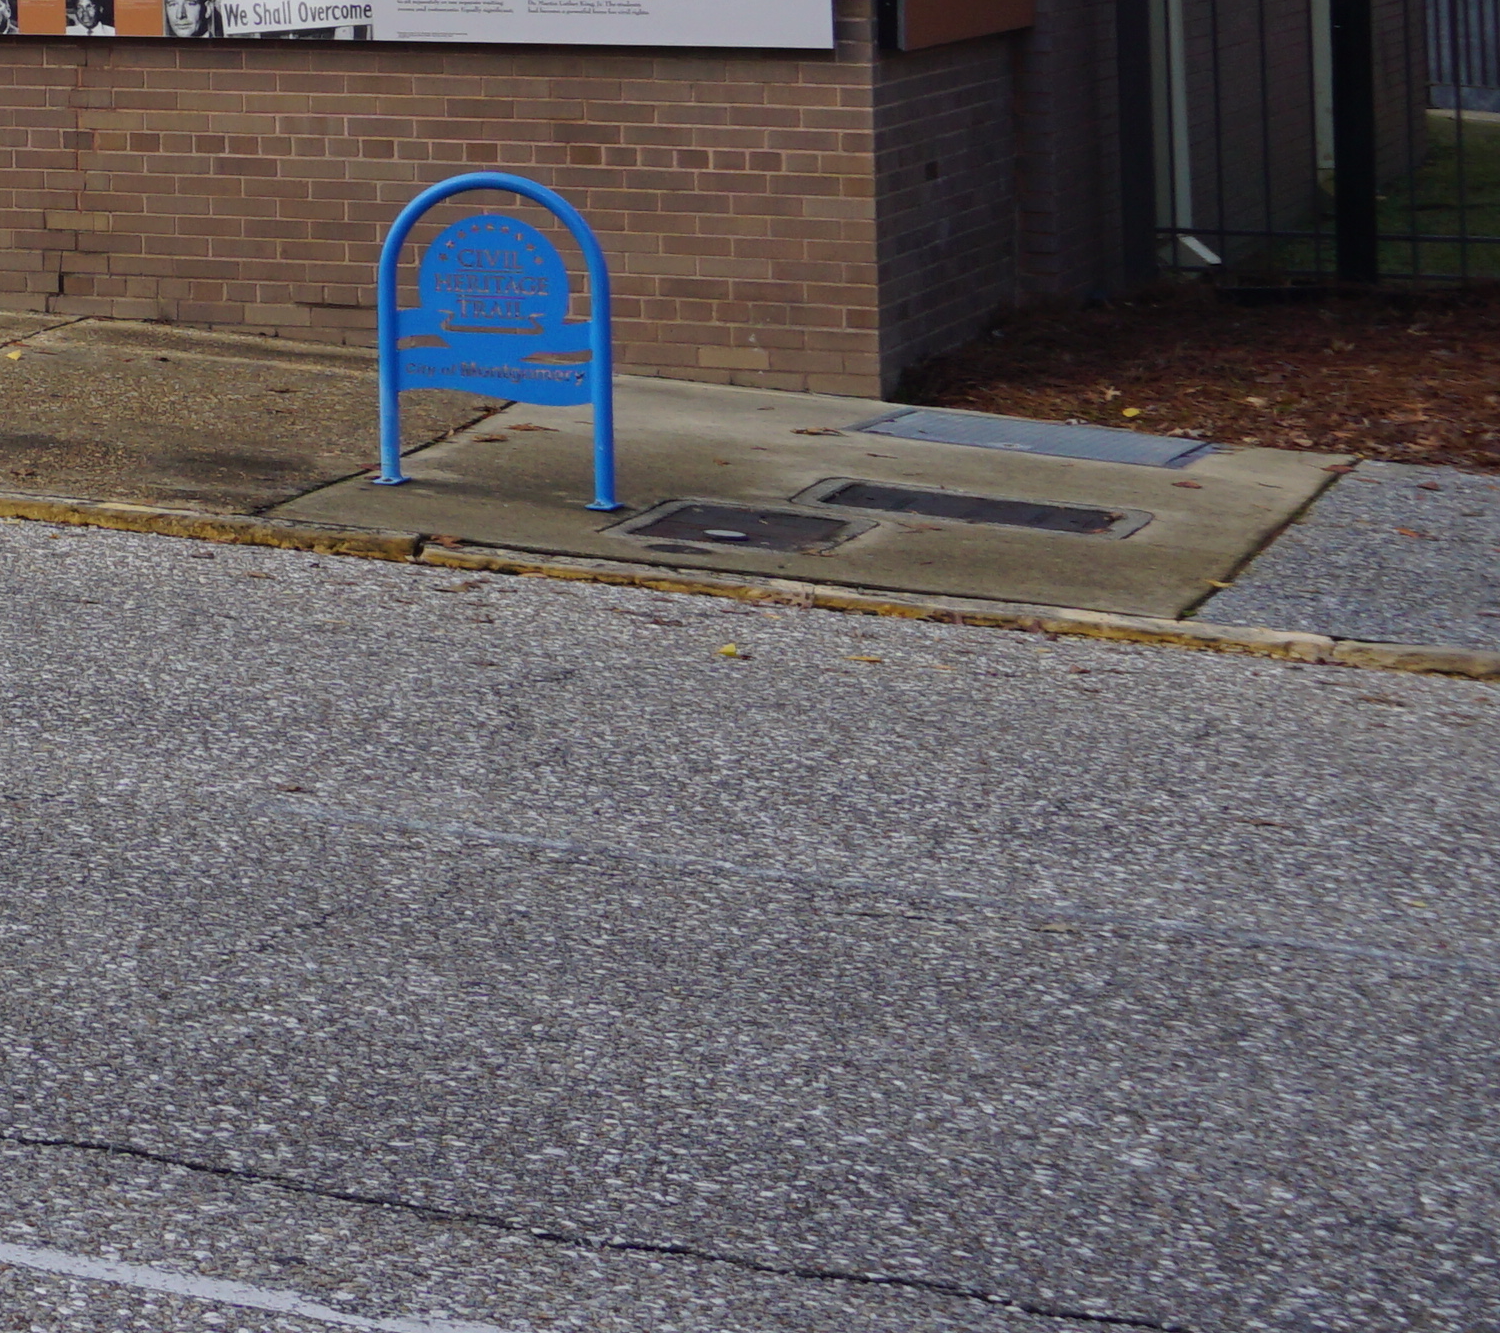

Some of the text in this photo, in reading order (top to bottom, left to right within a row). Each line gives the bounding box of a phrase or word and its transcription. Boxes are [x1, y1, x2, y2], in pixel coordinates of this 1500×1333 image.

[224, 0, 372, 28] We Shall Overcome
[457, 249, 524, 270] CIVIL
[434, 273, 549, 295] HERITAGE
[457, 299, 524, 319] TRAIL
[405, 362, 585, 387] City of Montgomery
